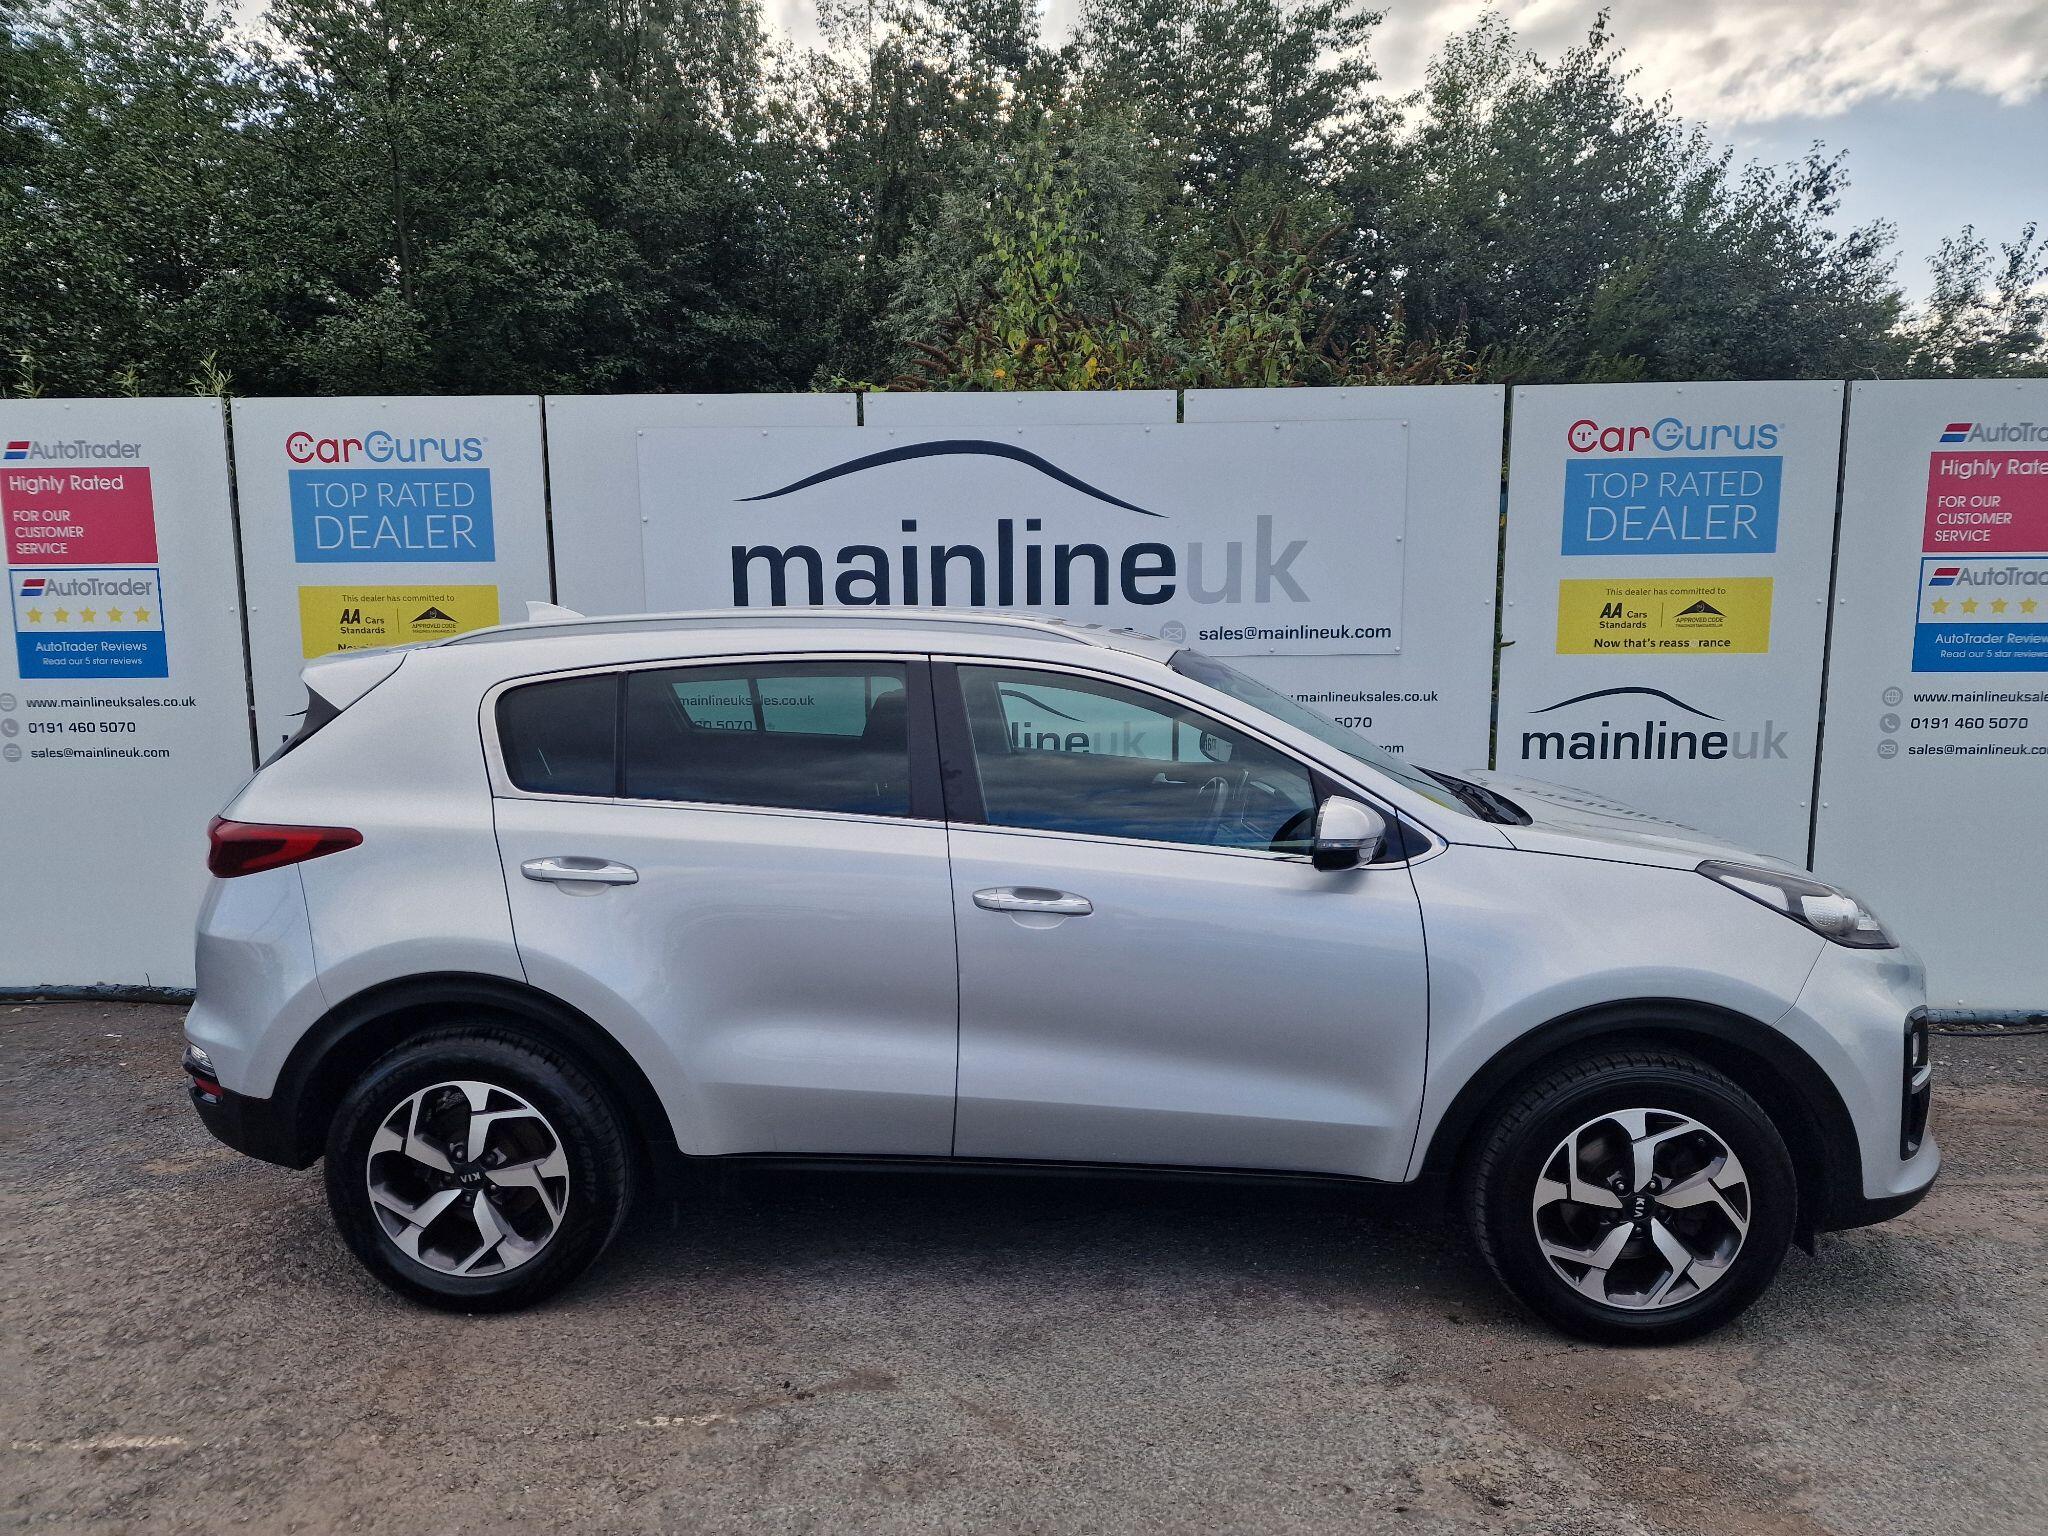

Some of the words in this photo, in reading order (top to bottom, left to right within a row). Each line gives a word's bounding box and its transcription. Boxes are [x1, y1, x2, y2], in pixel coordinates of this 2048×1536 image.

[1567, 417, 1779, 453] CarGurus
[29, 439, 141, 460] AutoTrader
[285, 430, 484, 464] CarGurus
[1941, 459, 2001, 480] Highly
[9, 475, 65, 495] Highly
[70, 475, 124, 491] Rated
[1584, 472, 1648, 499] TOP
[1659, 470, 1763, 498] RATED
[307, 482, 367, 508] TOP
[379, 482, 475, 508] RATED
[1938, 496, 1966, 507] FOR
[1970, 496, 2001, 507] OUR
[13, 510, 39, 522] FOR
[42, 510, 70, 522] OUR
[1937, 512, 2012, 525] CUSTOMER
[1586, 504, 1758, 542] DEALER
[14, 526, 84, 539] CUSTOMER
[314, 514, 477, 550] DEALER
[1934, 529, 1991, 542] SERVICE
[16, 543, 68, 555] SERVICE
[731, 514, 1313, 606] mainlineuk
[45, 578, 152, 597] AutoTrader
[1606, 588, 1622, 596] This
[1625, 588, 1651, 596] dealer
[1670, 587, 1715, 595] committed
[342, 594, 359, 602] This
[361, 594, 385, 602] dealer
[387, 594, 400, 602] has
[402, 594, 445, 602] committed
[340, 608, 361, 624] AA
[365, 616, 385, 625] Cars
[1600, 603, 1623, 618] AA
[1627, 611, 1648, 619] Cars
[340, 626, 386, 634] Standards
[1600, 621, 1647, 629] Standards
[1199, 624, 1392, 641] sales@mainlineuk.com
[1935, 633, 2003, 644] AutoTrader
[35, 641, 98, 652] AutoTrader
[101, 641, 147, 652] Reviews
[1594, 639, 1621, 648] Now
[1624, 638, 1656, 648] that's
[1659, 639, 1731, 648] reassrance
[1940, 650, 1966, 659] Read
[1986, 650, 1993, 658] 5
[1995, 650, 2012, 658] star
[42, 657, 66, 666] Read
[68, 658, 83, 666] our
[85, 657, 91, 665] 5
[92, 657, 108, 665] star
[110, 657, 143, 666] reviews
[26, 696, 196, 708] www.mainlineuksales.co.uk
[28, 722, 63, 734] 0191
[69, 722, 96, 733] 460
[100, 721, 136, 733] 5070
[1910, 717, 1949, 730] 0191
[1954, 717, 1985, 729] 460
[1988, 717, 2028, 729] 5070
[1521, 720, 1788, 760] mainlineuk
[30, 747, 170, 760] sales@mainlineuk.com
[1633, 1197, 1645, 1217] KIA
